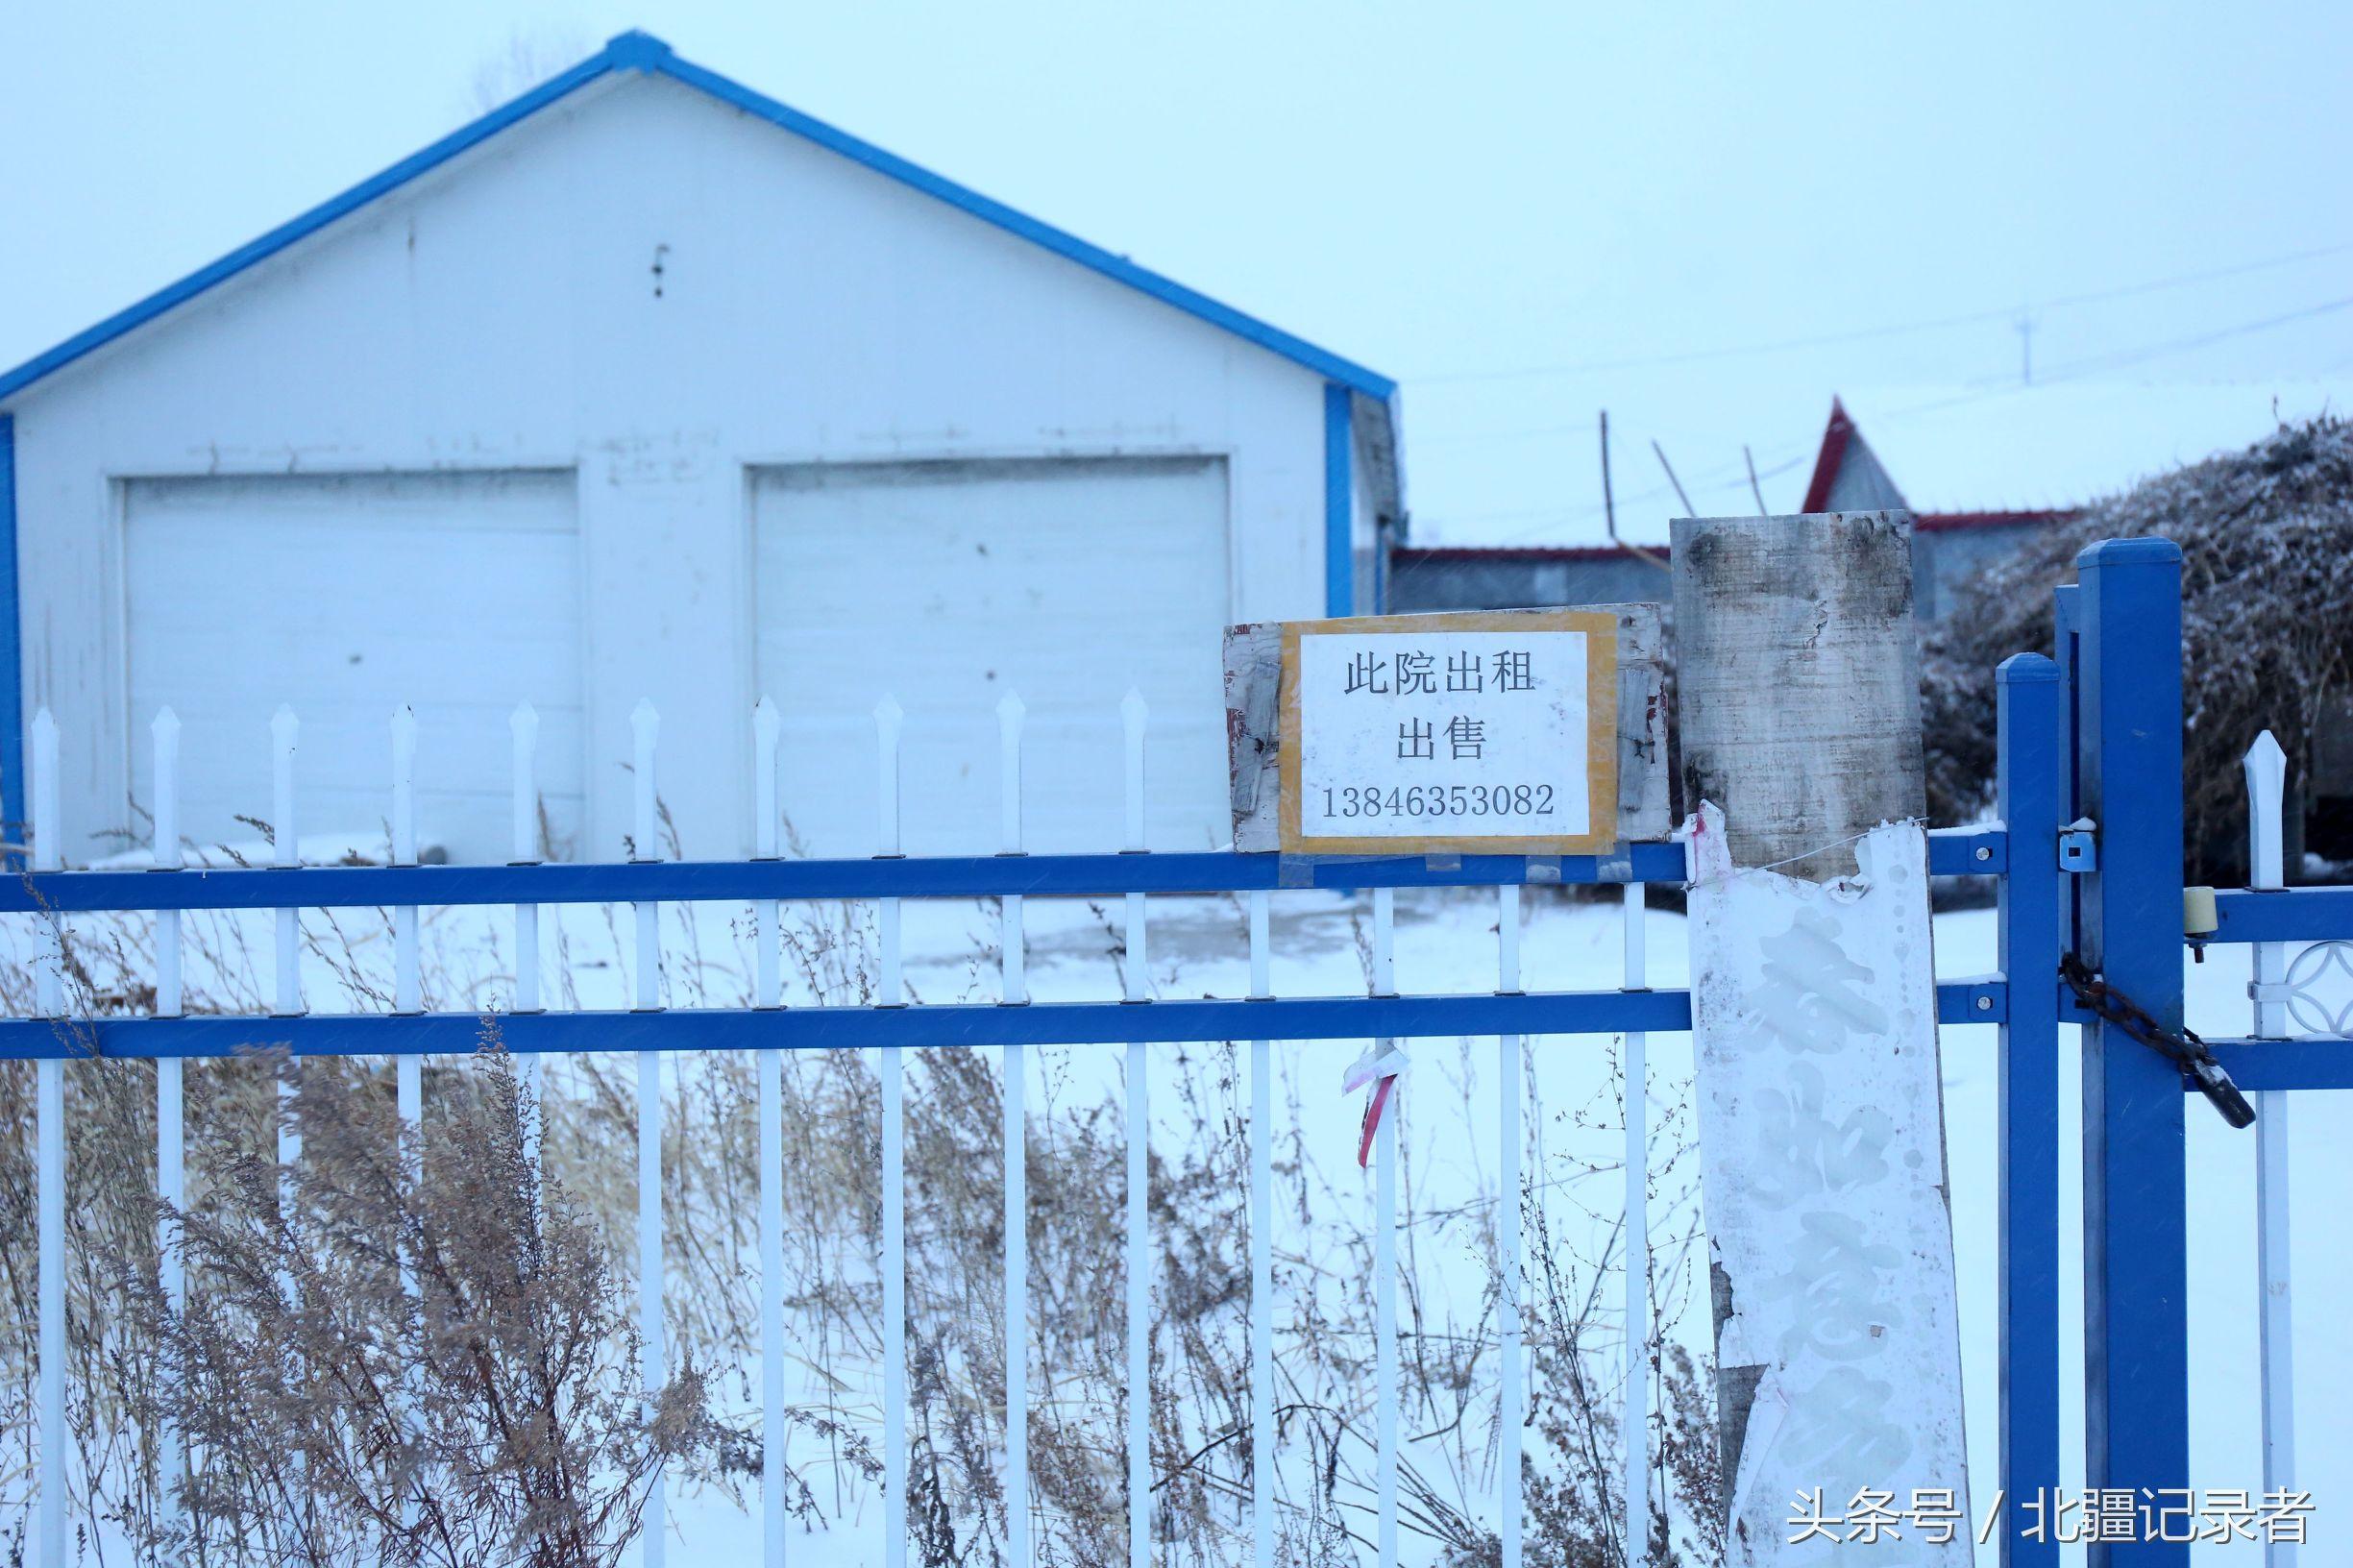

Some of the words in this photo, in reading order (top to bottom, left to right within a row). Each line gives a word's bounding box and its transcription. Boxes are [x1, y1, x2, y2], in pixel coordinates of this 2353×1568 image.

[1343, 649, 1536, 697] 此院出租
[1397, 715, 1487, 761] 出售
[1322, 784, 1554, 818] 13846353082
